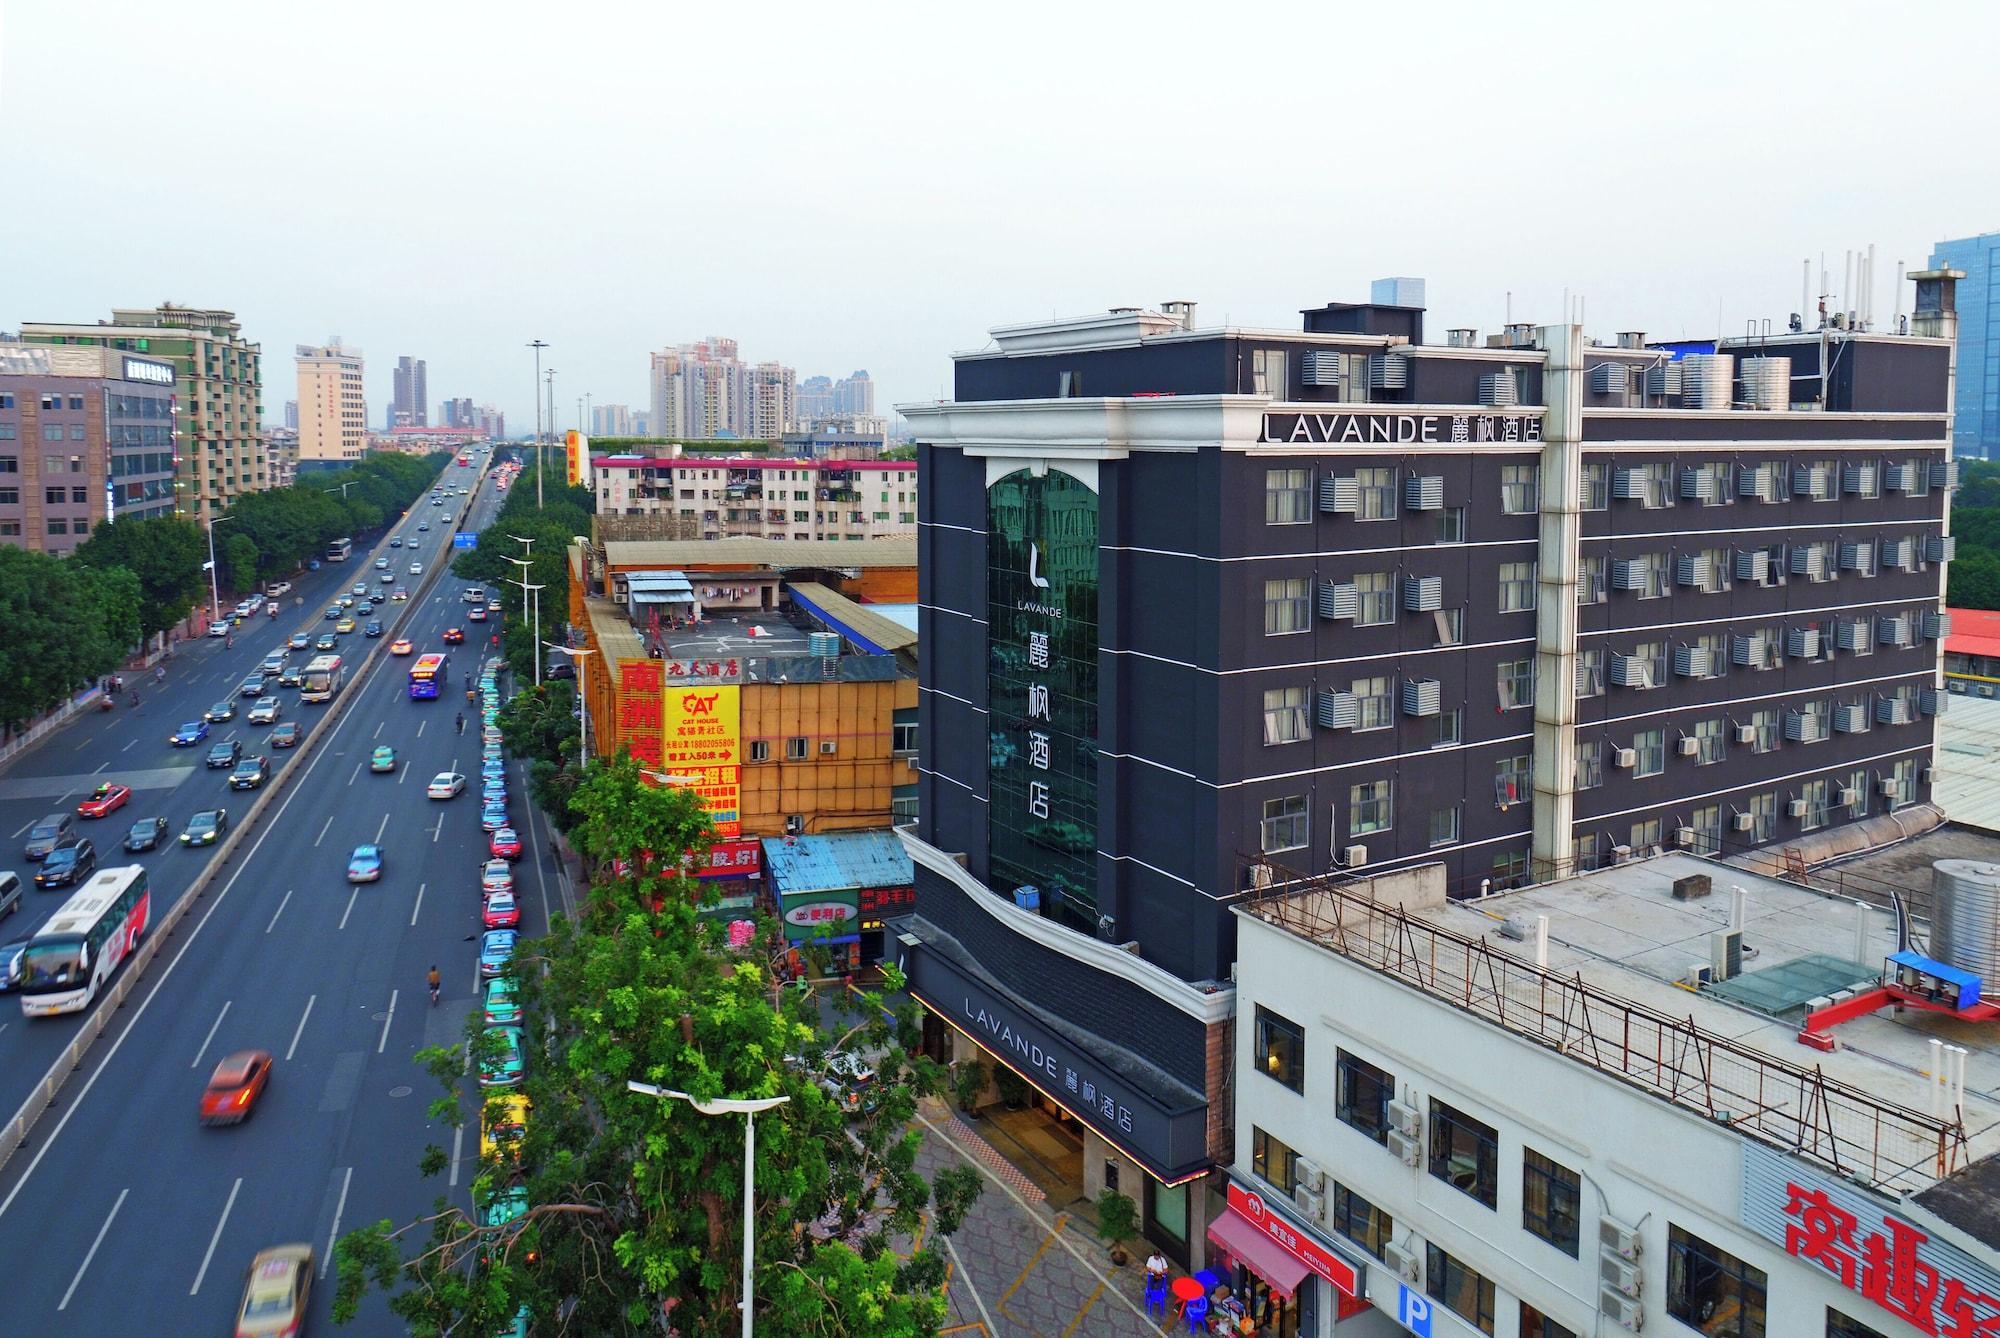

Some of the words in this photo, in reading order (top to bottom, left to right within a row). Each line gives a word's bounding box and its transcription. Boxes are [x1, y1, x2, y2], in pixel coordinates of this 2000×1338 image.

[1264, 414, 1438, 443] LAVANDE
[1451, 415, 1541, 443] 麗枫酒店
[1018, 600, 1062, 619] LAVANDE
[668, 659, 738, 679] 九天酒店
[682, 692, 719, 717] CAT
[1028, 631, 1050, 820] 麗枫酒店
[965, 997, 1057, 1079] LAVANDE
[1065, 1067, 1133, 1133] 麗枫酒店
[1270, 1221, 1297, 1250] 美宜佳
[1410, 1291, 1429, 1330] P
